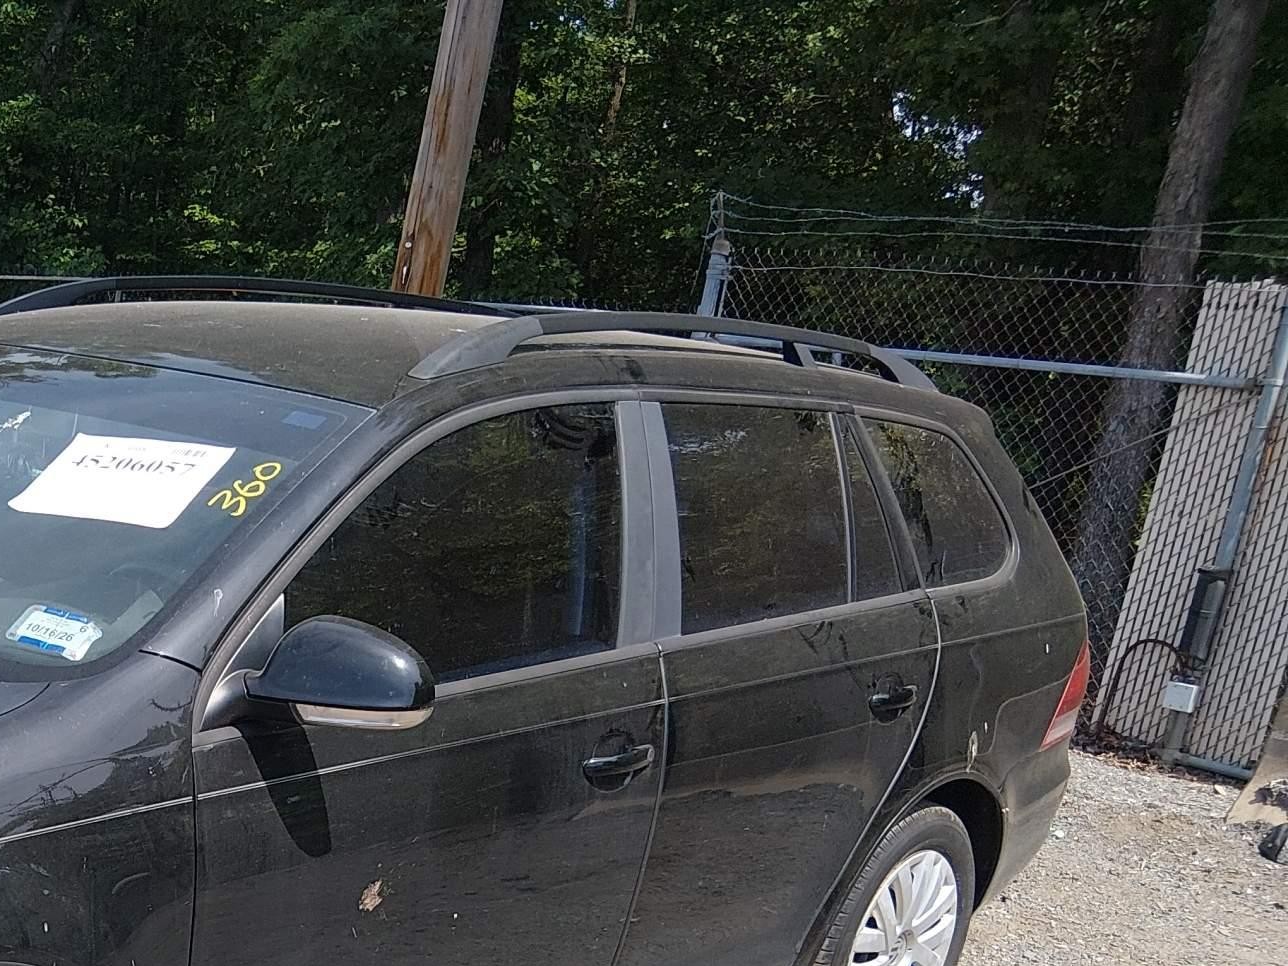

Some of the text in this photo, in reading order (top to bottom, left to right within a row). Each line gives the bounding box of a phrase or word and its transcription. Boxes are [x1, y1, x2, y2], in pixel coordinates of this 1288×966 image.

[72, 454, 197, 476] 45206057
[207, 461, 282, 517] 360
[25, 622, 76, 642] 10/16/26
